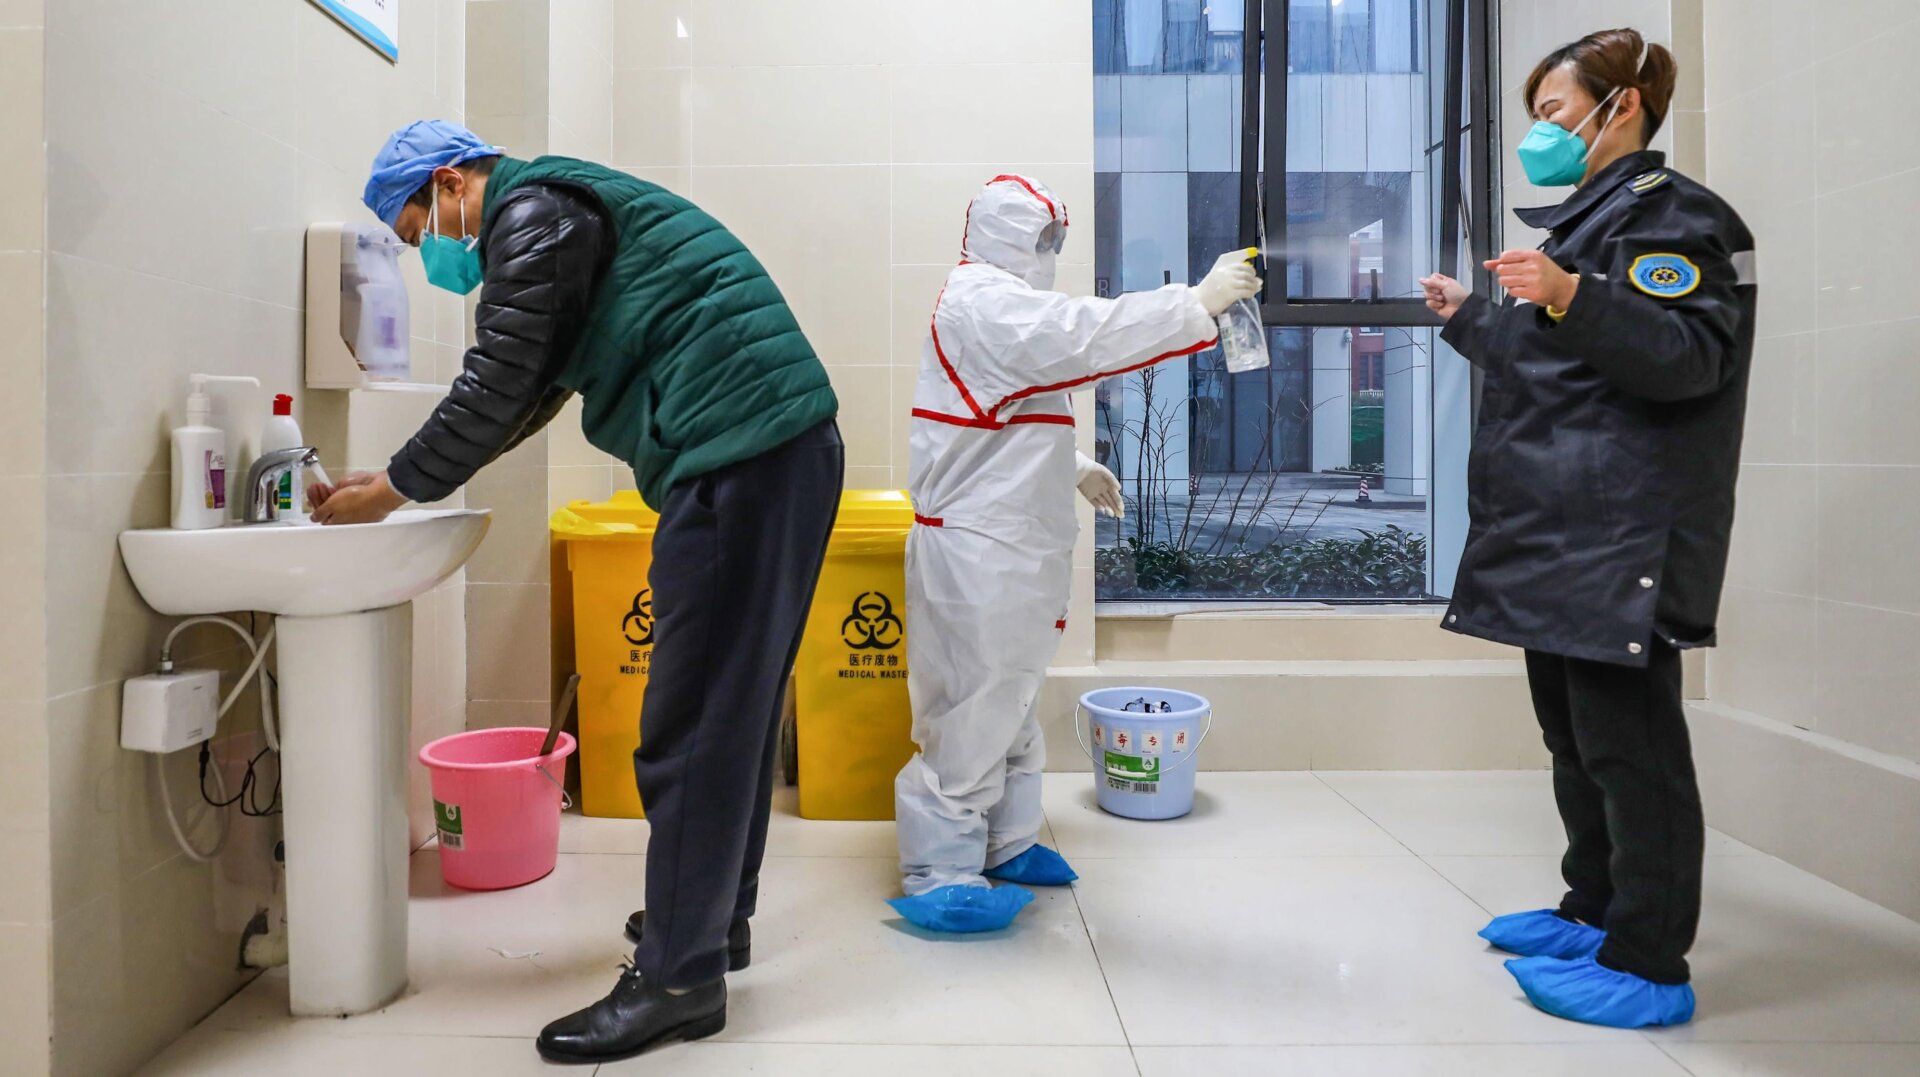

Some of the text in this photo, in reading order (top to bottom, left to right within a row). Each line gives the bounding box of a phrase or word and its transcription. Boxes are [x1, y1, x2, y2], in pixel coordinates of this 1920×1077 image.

[849, 653, 898, 667] 医疗废物
[838, 669, 876, 679] MEDICAL
